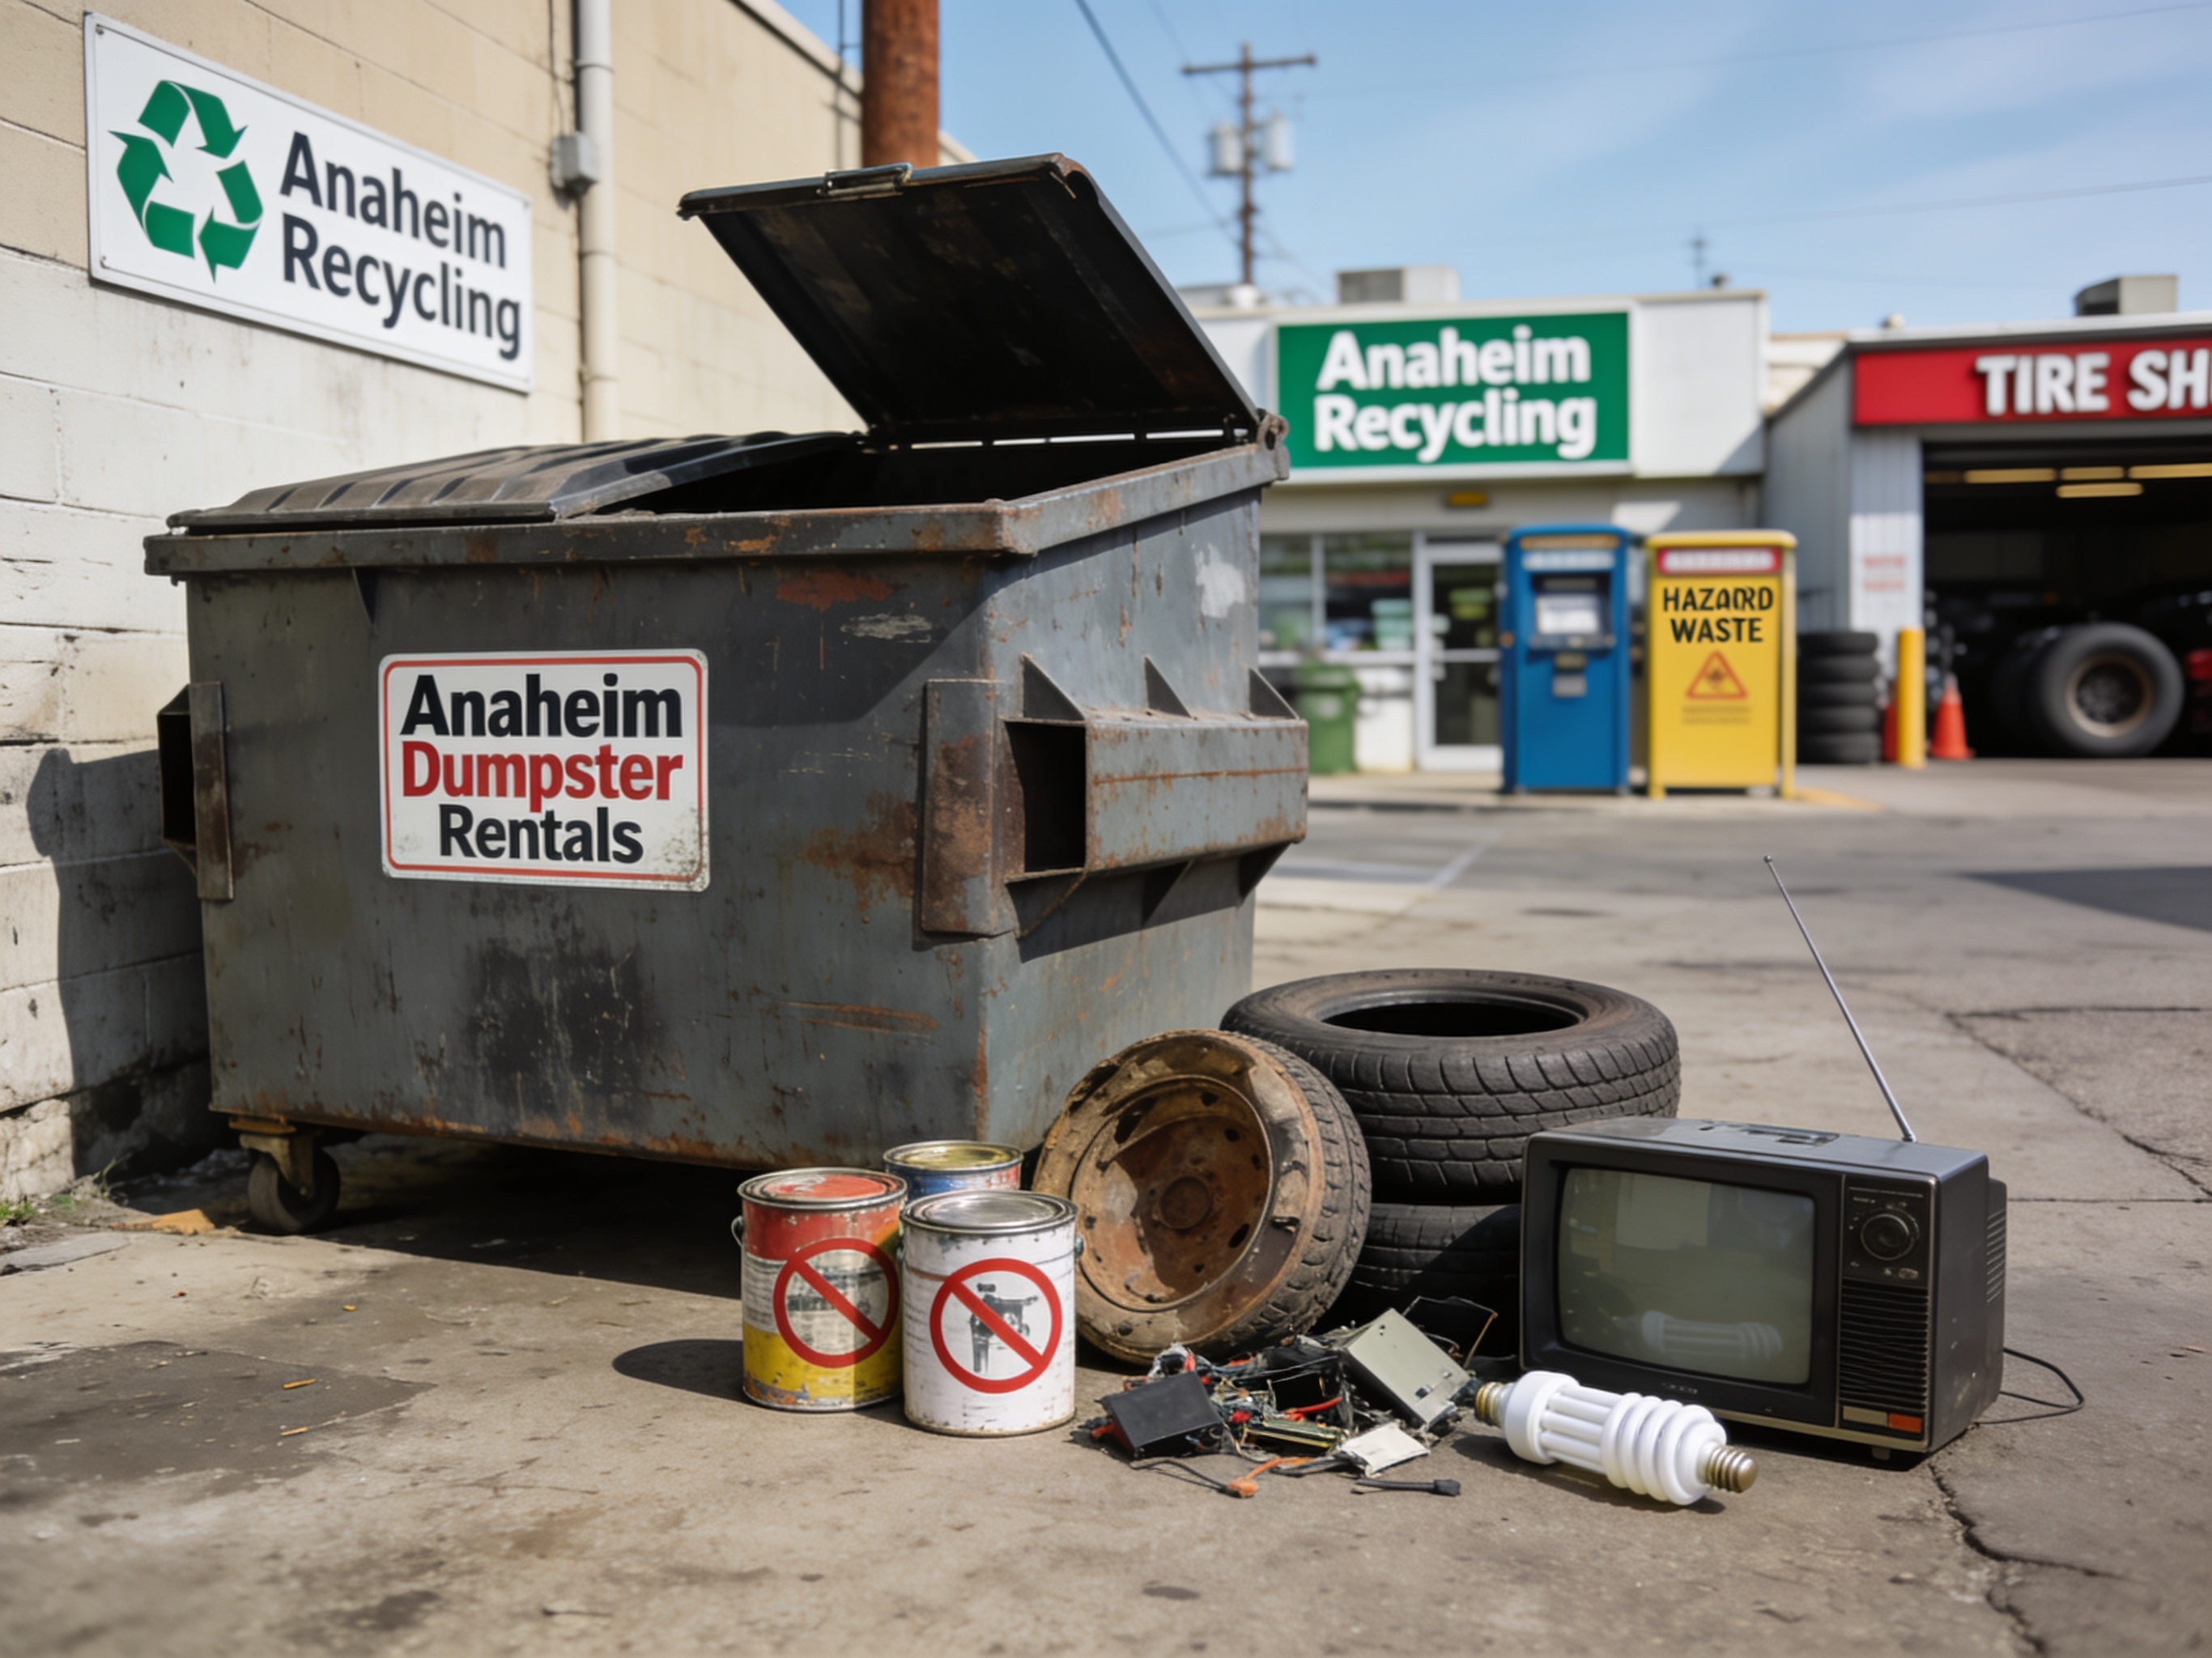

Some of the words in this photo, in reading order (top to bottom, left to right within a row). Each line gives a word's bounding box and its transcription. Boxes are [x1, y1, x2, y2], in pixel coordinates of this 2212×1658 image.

[279, 130, 507, 270] Anaheim
[283, 211, 521, 361] Recycling
[1315, 325, 1592, 391] Anaheim
[1975, 351, 2111, 416] TIRE
[2126, 348, 2212, 412] SH
[1313, 387, 1597, 463] Recycling
[1670, 617, 1763, 644] WASTE
[400, 673, 683, 738] Anaheim
[402, 741, 683, 813] Dumpster
[439, 804, 644, 864] Rentals
